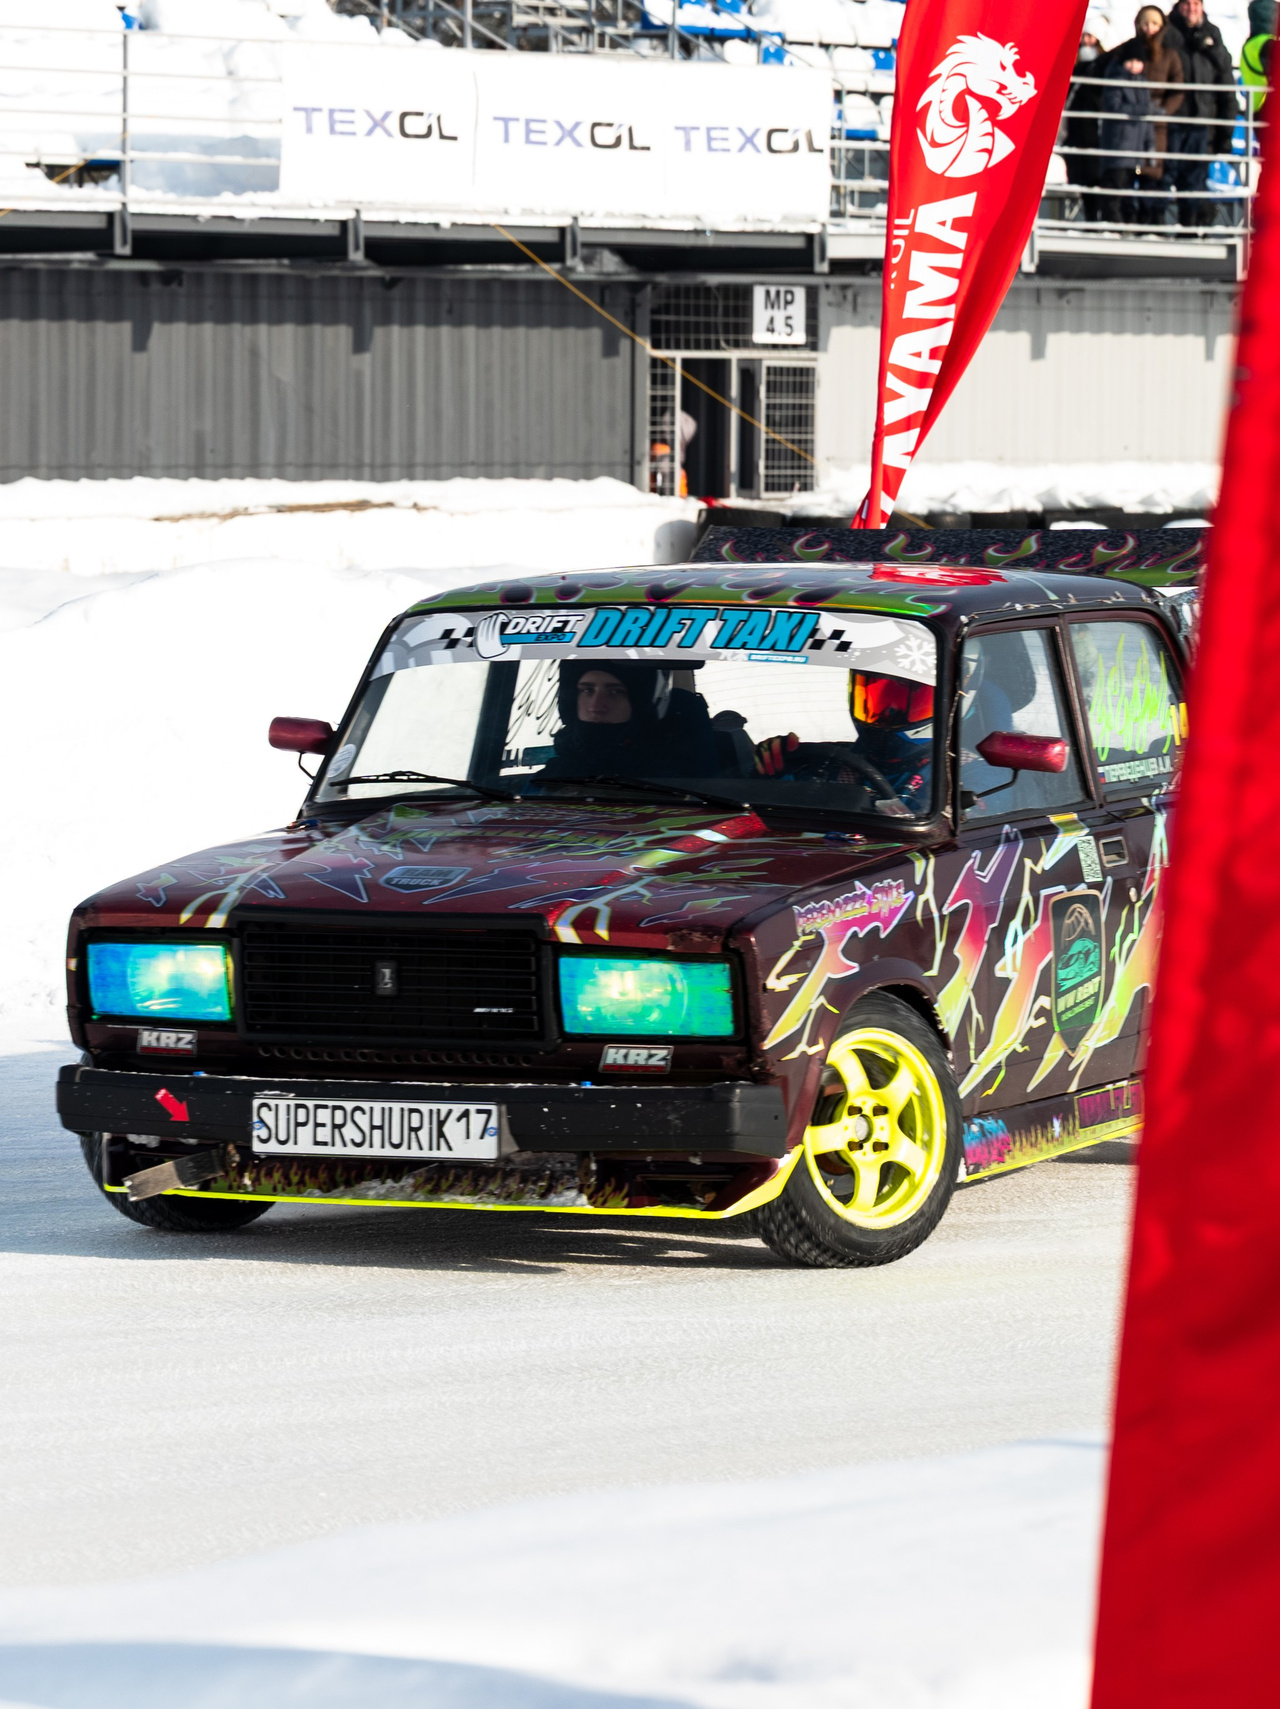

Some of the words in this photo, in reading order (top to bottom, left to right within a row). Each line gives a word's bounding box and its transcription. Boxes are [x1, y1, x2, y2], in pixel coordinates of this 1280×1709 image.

[764, 289, 795, 310] MP
[766, 315, 794, 336] 4.5
[503, 613, 587, 634] DRIFT
[576, 607, 719, 648] DRIFT
[710, 608, 821, 652] TAXI
[535, 633, 568, 642] EXPO
[391, 877, 443, 886] TRUCK
[141, 1031, 194, 1048] KRZ
[605, 1048, 669, 1065] KRZ
